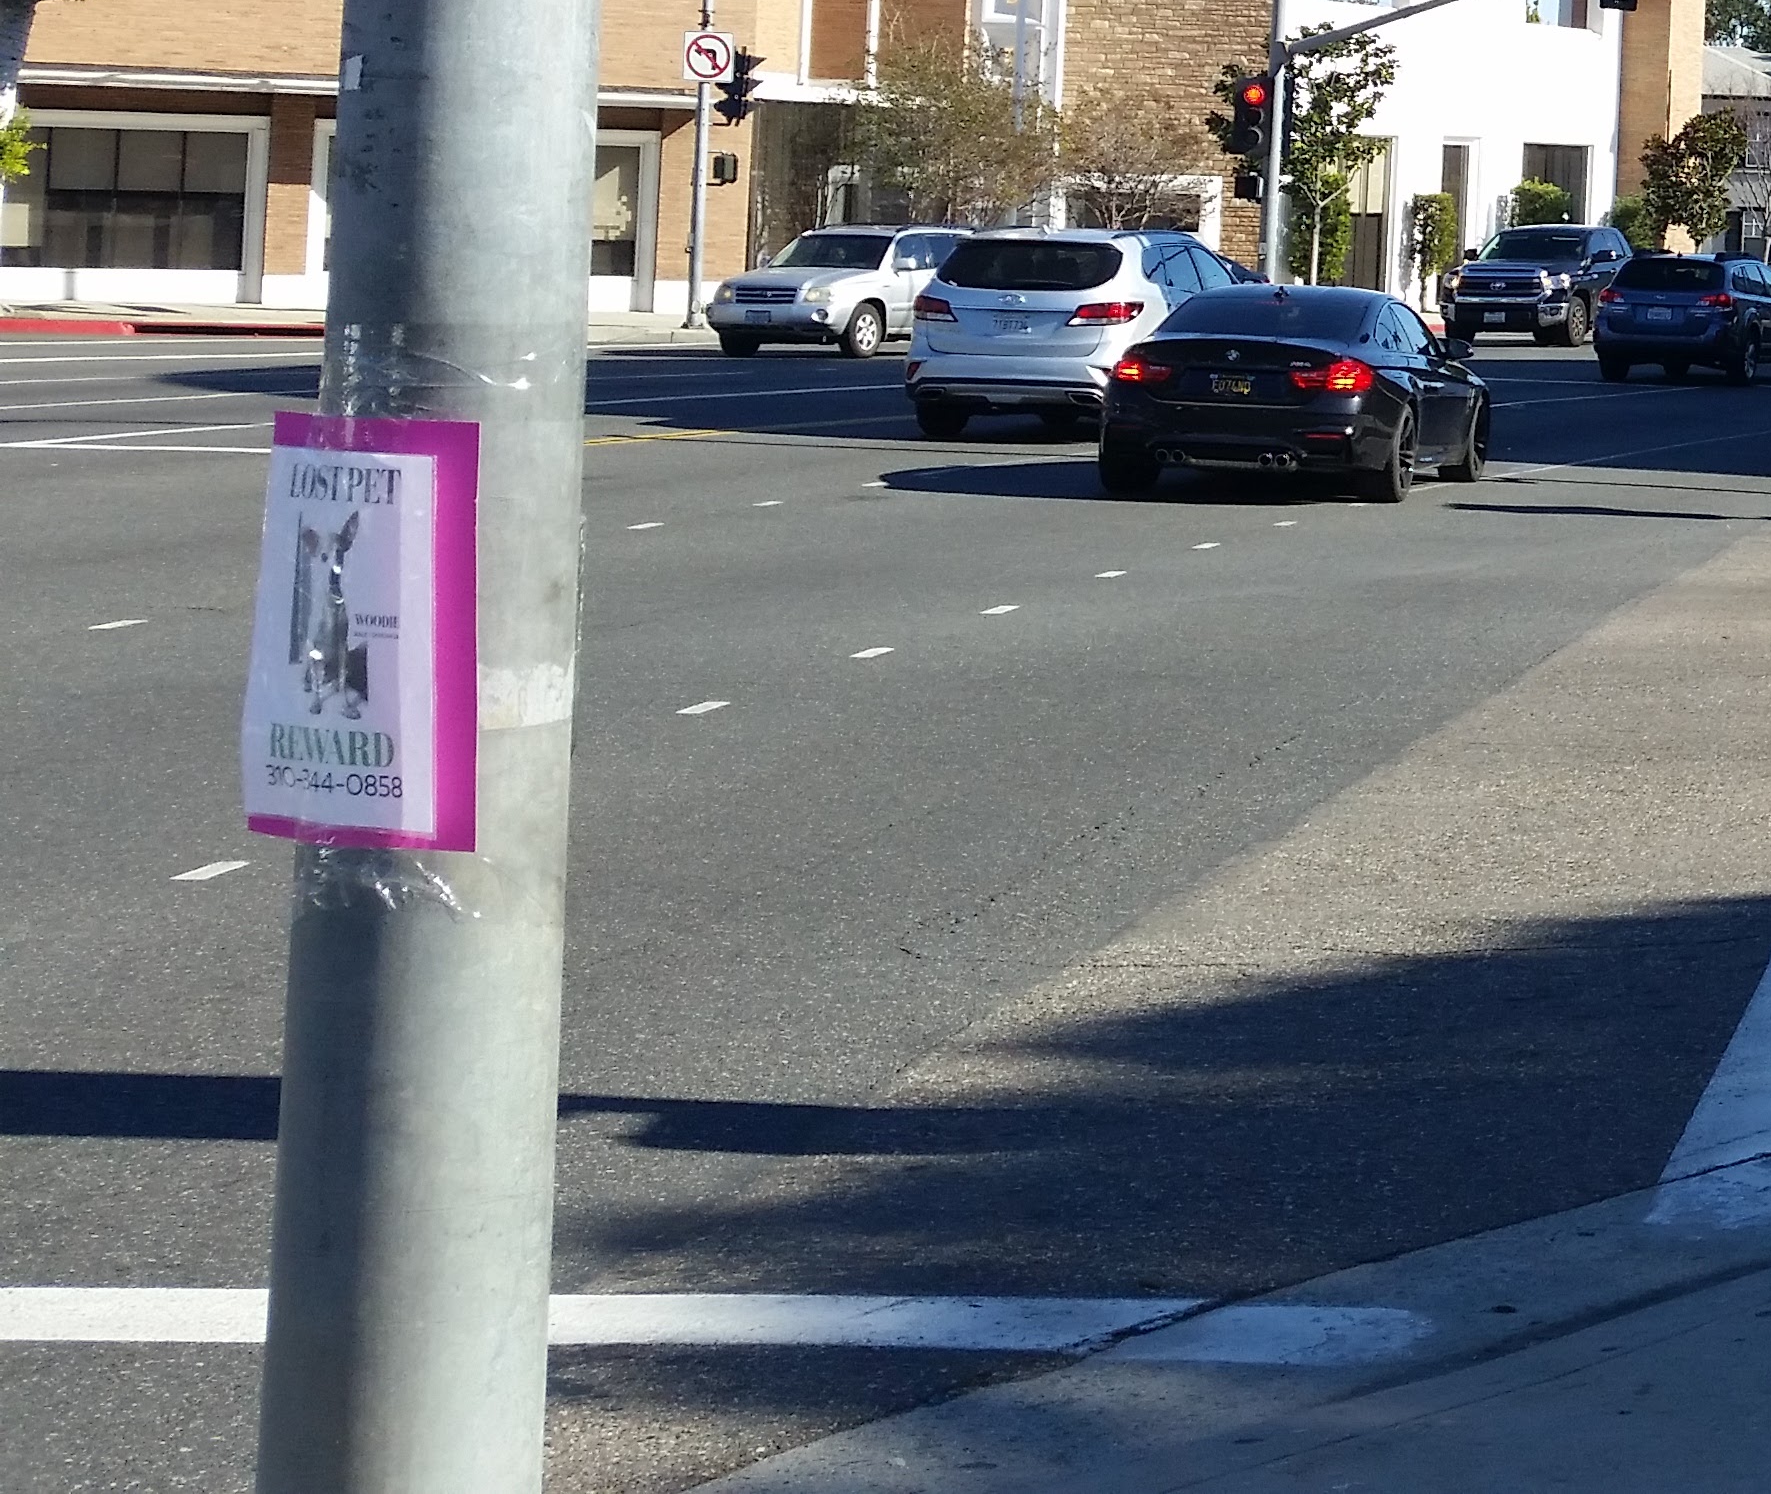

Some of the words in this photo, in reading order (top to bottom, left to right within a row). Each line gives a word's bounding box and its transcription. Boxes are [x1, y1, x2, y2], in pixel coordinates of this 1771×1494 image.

[290, 463, 344, 501] LOST
[347, 467, 402, 505] PET
[269, 722, 395, 768] REWARD
